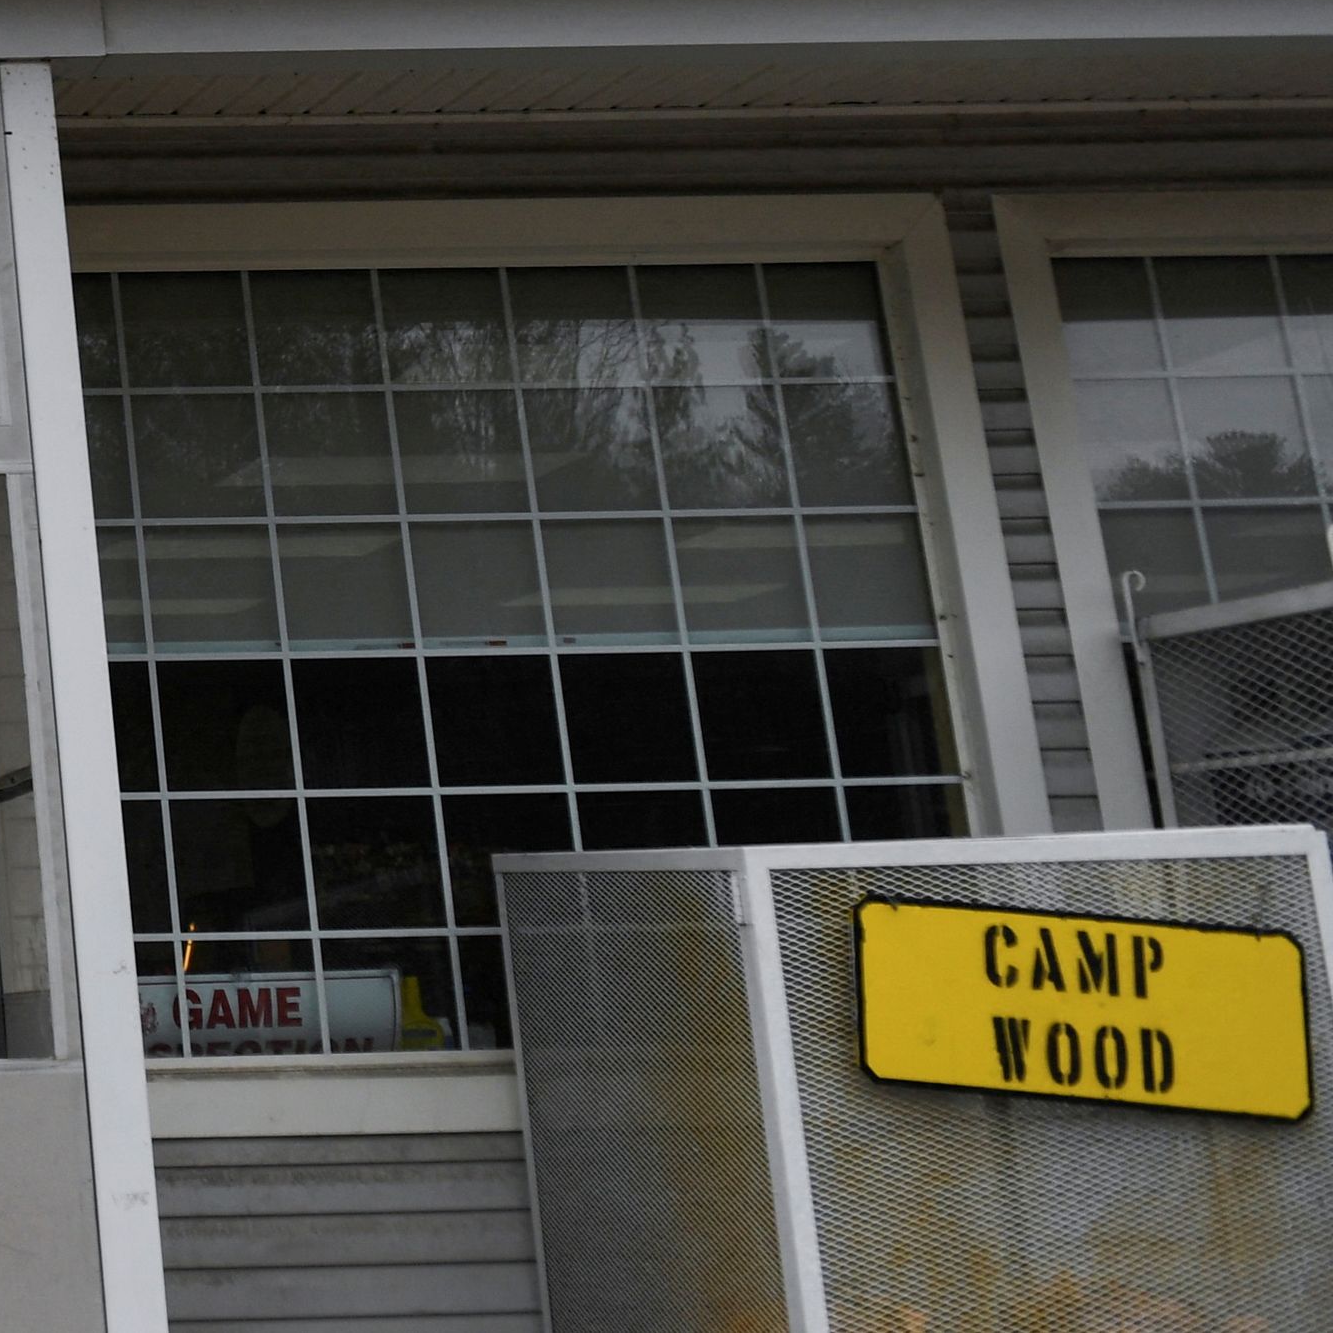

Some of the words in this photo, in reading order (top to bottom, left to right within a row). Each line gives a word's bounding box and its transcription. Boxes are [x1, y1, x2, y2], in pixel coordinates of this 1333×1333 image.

[983, 924, 1166, 1000] CAMP
[172, 986, 303, 1030] GAME
[992, 1016, 1176, 1095] WOOD
